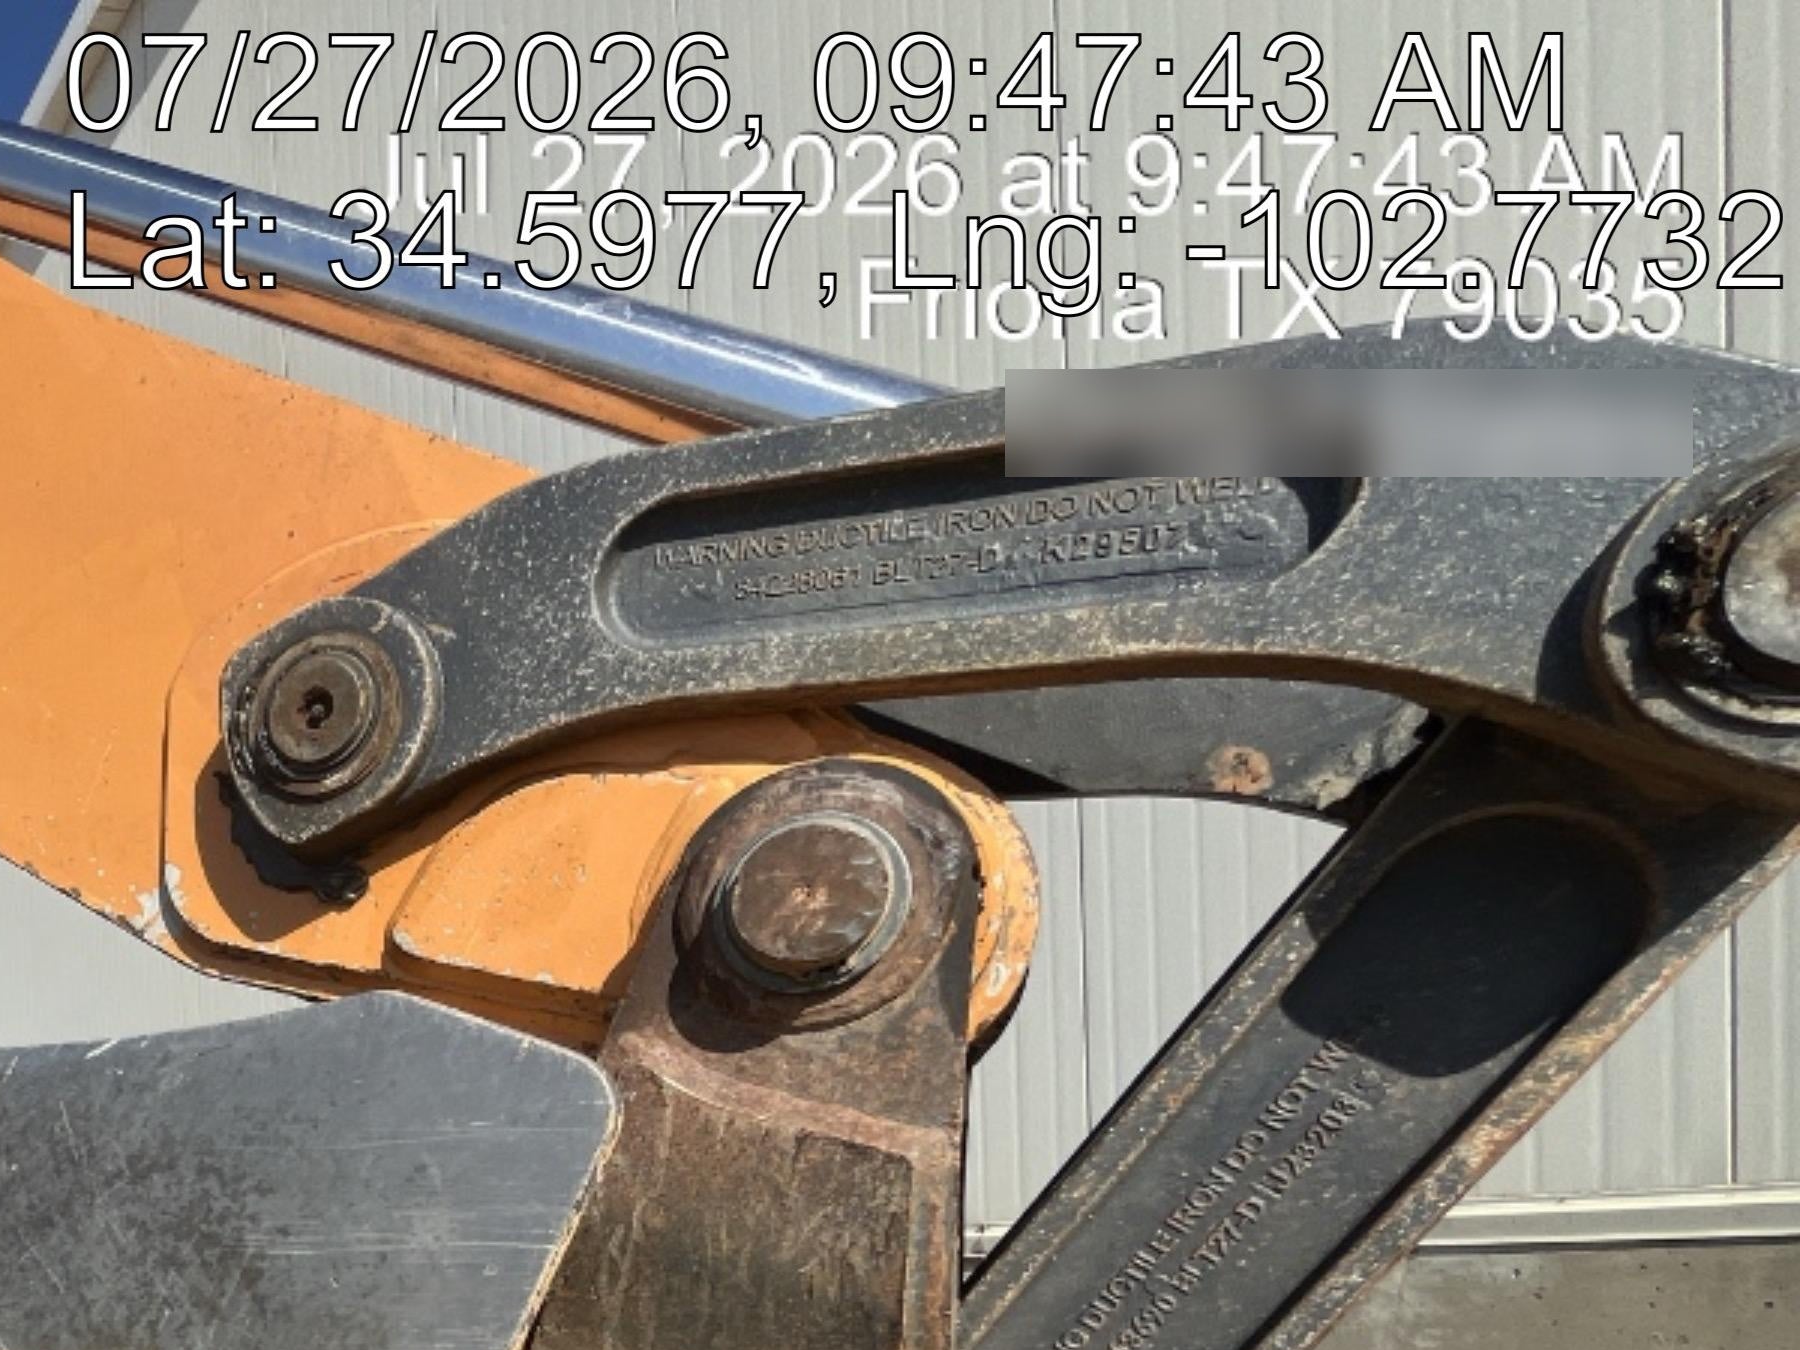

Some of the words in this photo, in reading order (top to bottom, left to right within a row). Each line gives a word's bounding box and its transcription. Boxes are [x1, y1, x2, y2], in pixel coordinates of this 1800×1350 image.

[935, 502, 1017, 538] IRON
[1026, 496, 1076, 526] DO
[1088, 484, 1165, 516] NOT
[1164, 1165, 1236, 1234] IRON
[1220, 1129, 1270, 1172] DO
[1256, 1067, 1321, 1131] NOT
